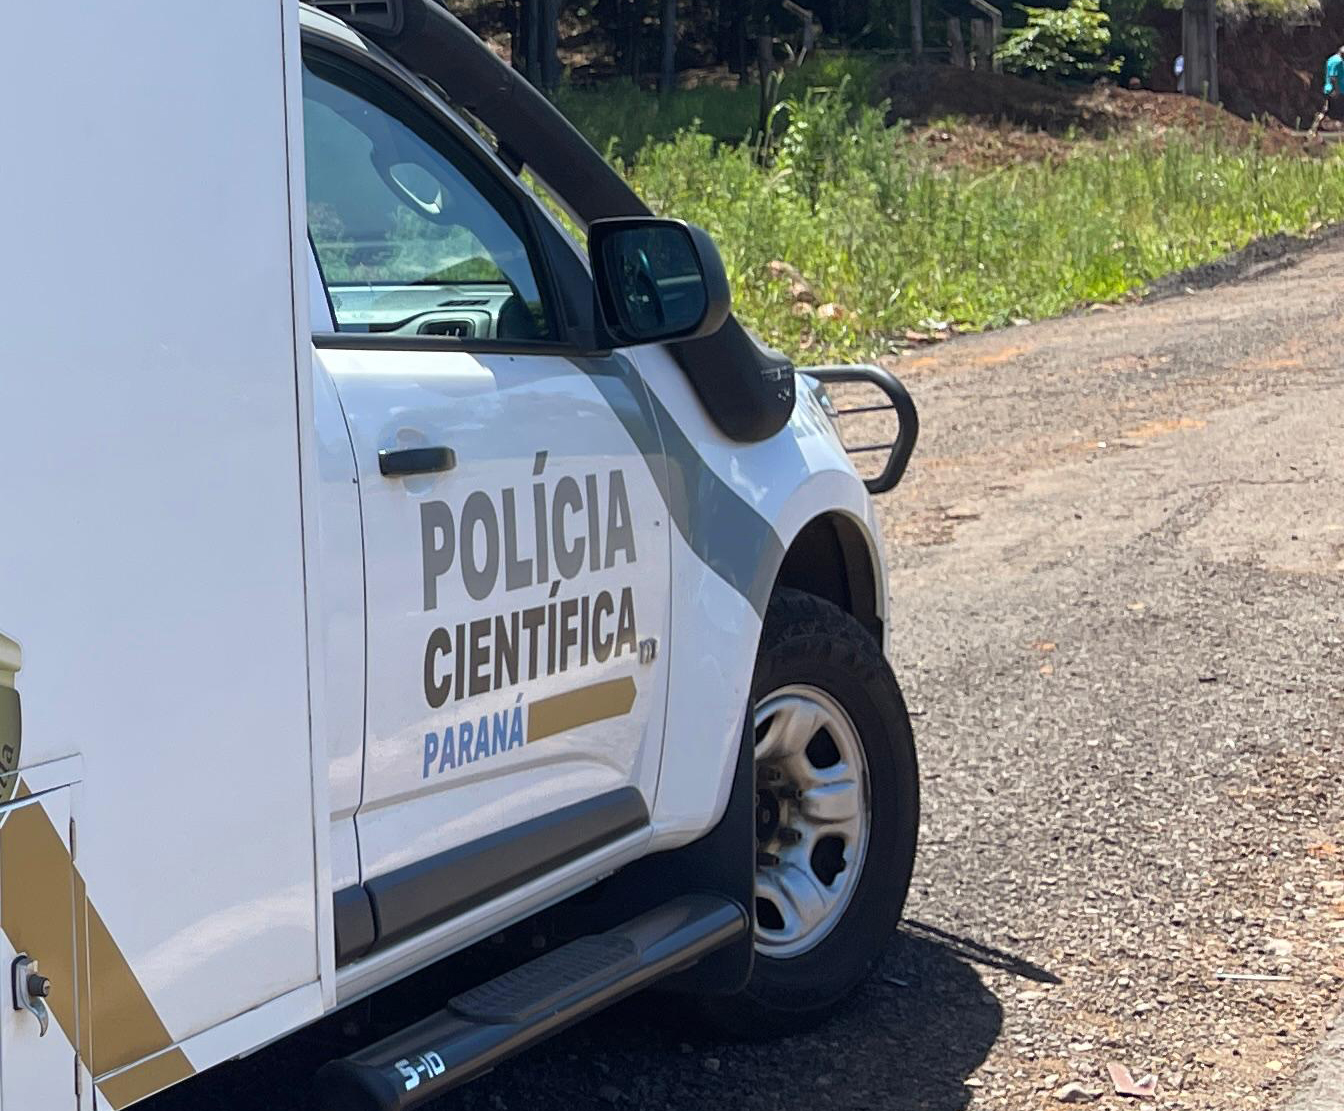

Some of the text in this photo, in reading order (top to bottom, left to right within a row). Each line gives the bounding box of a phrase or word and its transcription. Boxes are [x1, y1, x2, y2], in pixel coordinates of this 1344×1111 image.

[419, 450, 637, 612] POLÍCIA
[423, 579, 637, 710] CIENTÍFICA
[422, 692, 525, 780] PARANÁ
[394, 1051, 446, 1091] S-10
